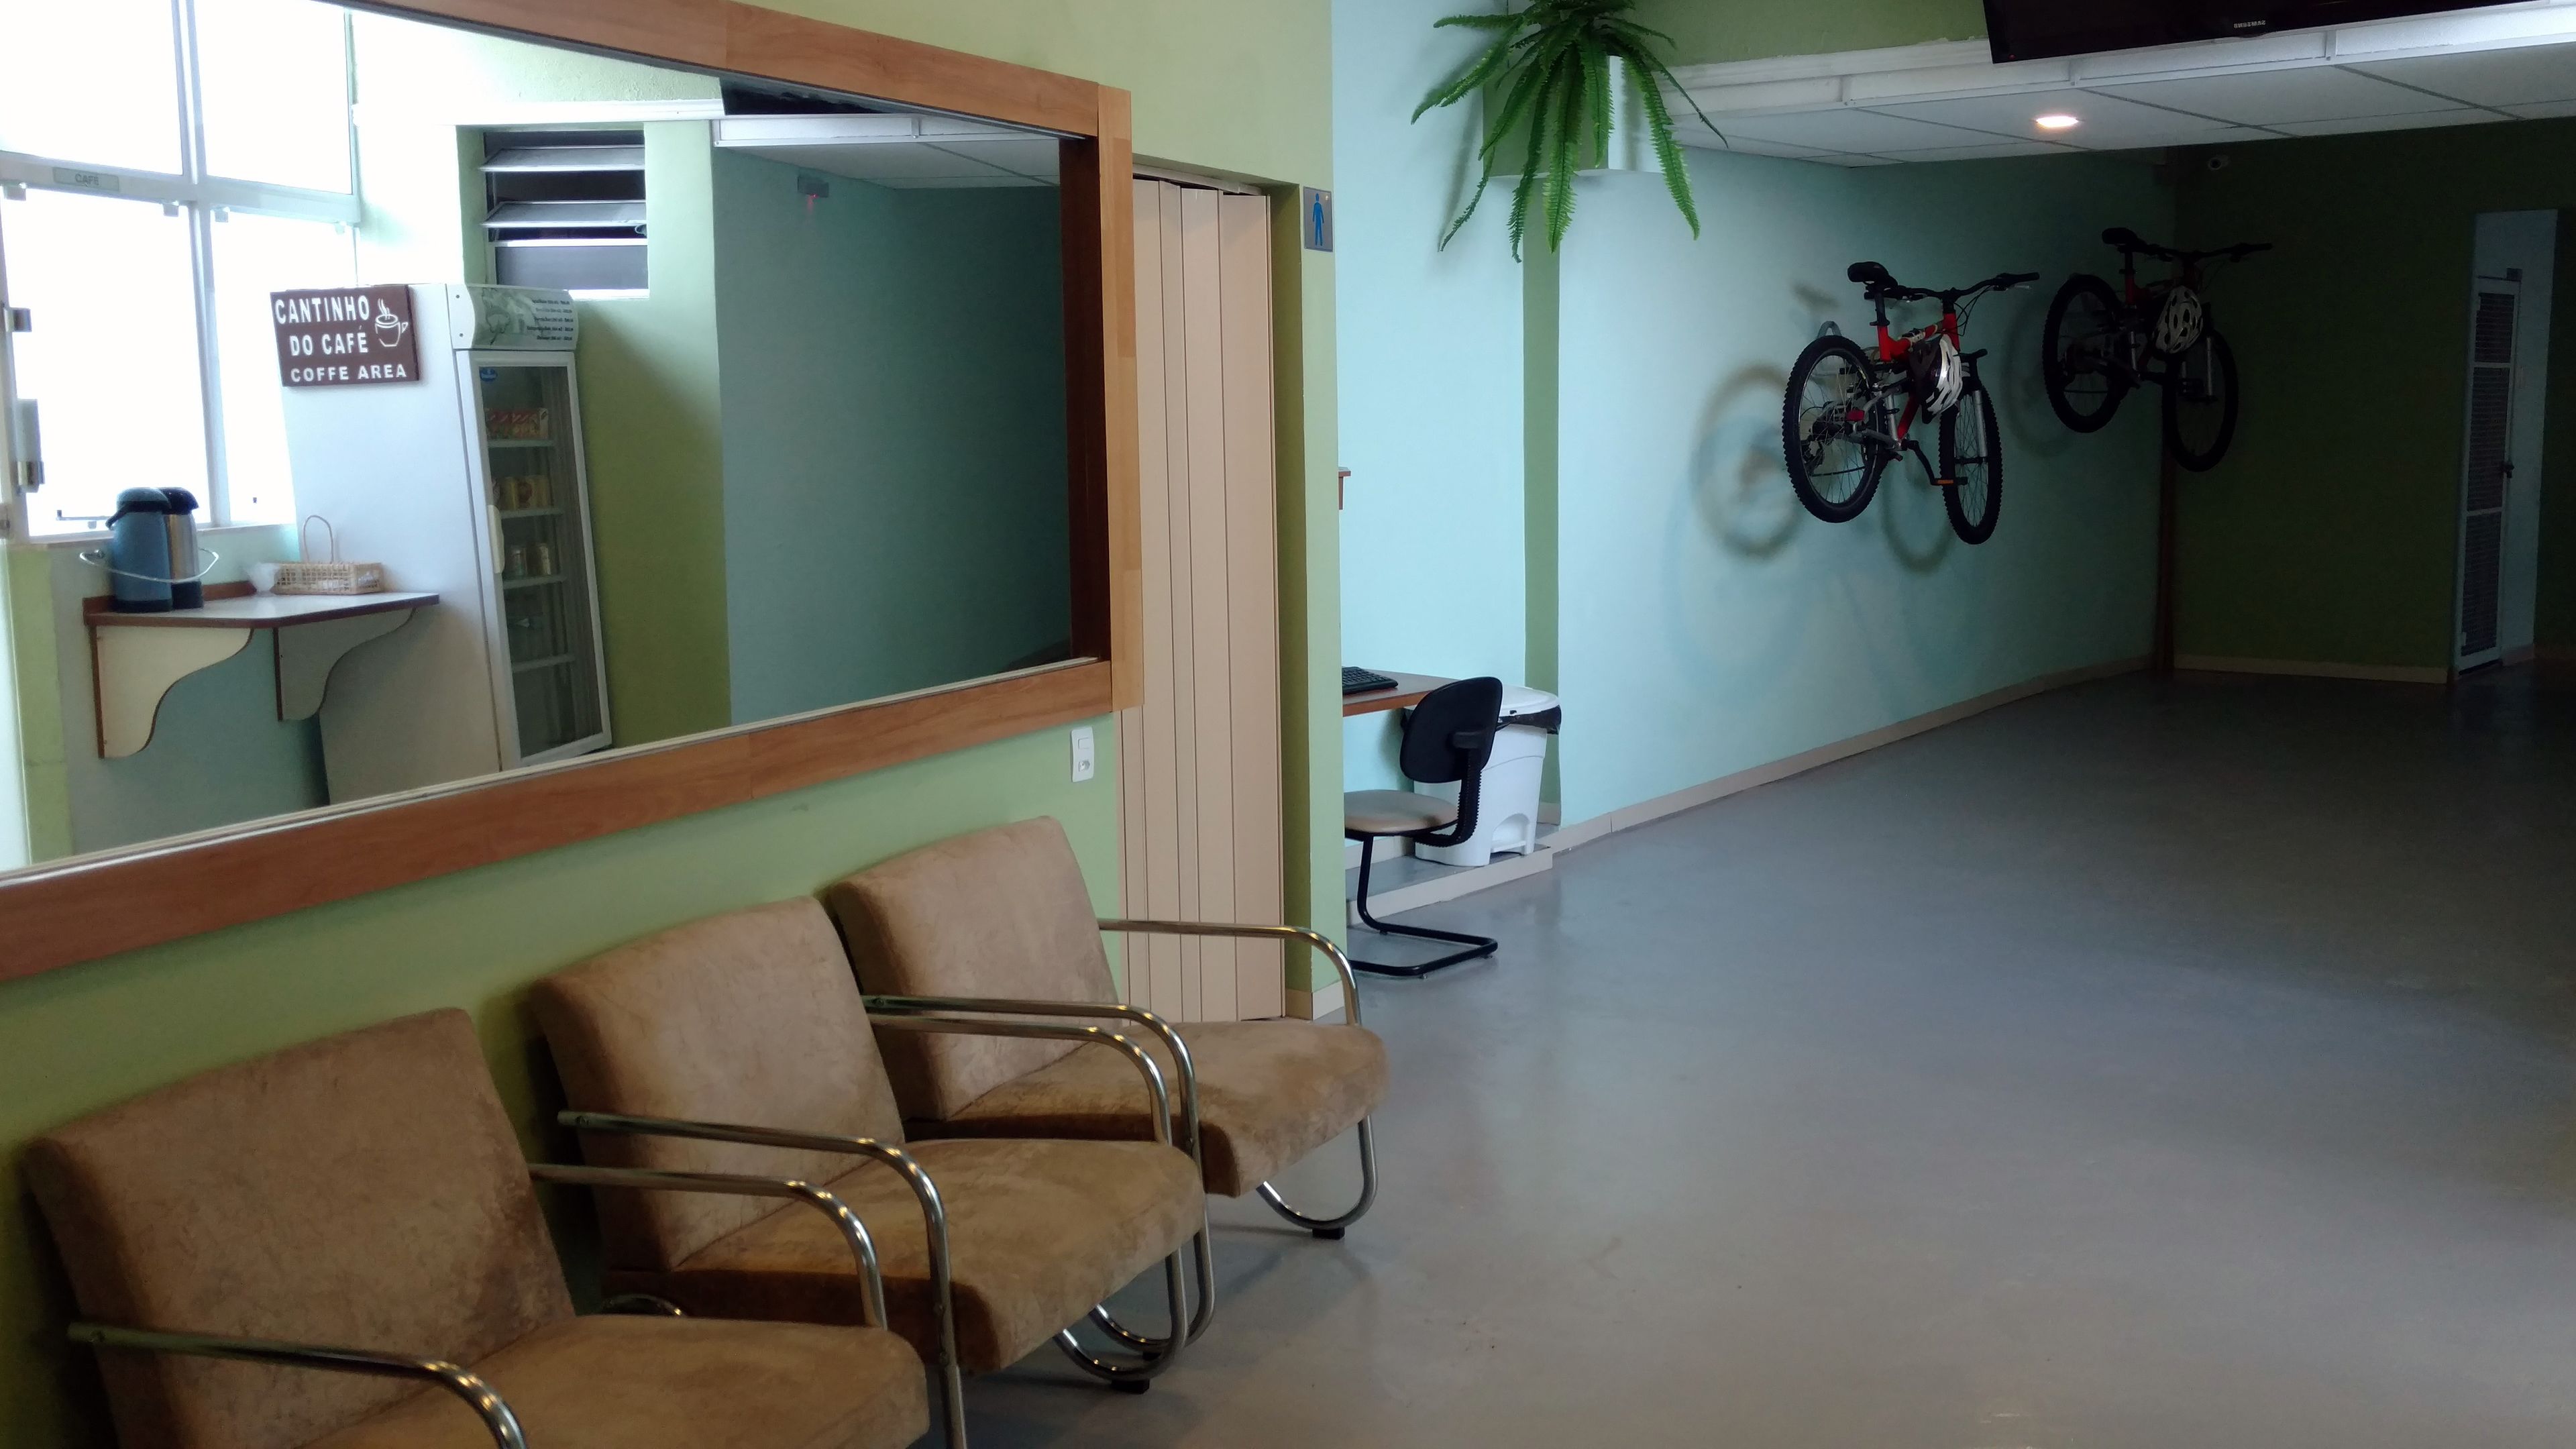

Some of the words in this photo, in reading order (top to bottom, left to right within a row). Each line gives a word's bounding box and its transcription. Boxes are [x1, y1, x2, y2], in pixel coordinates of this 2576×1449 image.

[275, 295, 370, 324] CANTINHO
[290, 335, 313, 356] DO
[321, 325, 369, 355] CAFÉ
[290, 366, 349, 382] COFFE
[358, 364, 407, 380] AREA
